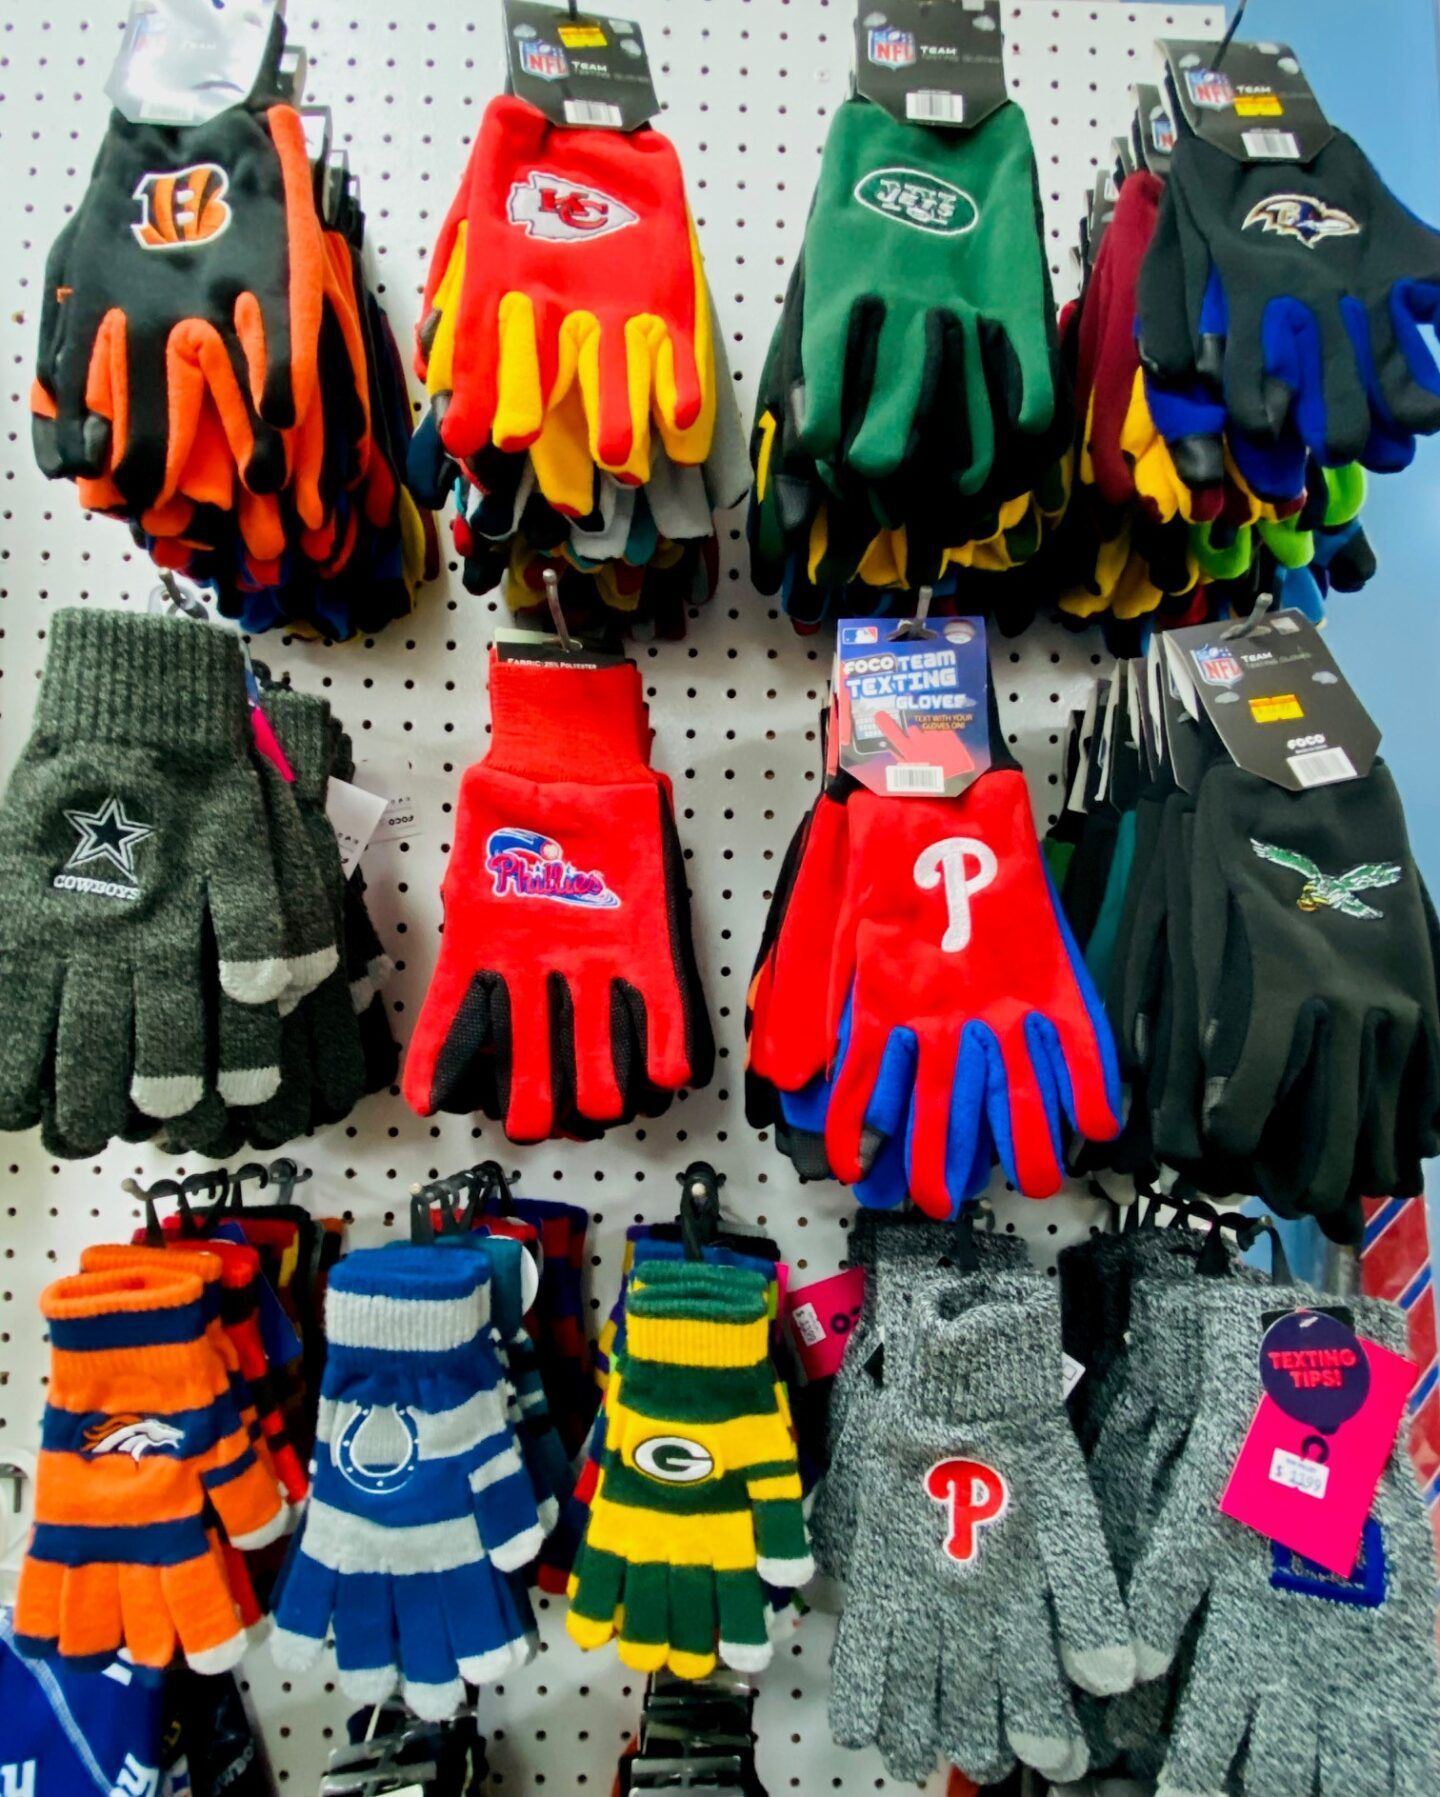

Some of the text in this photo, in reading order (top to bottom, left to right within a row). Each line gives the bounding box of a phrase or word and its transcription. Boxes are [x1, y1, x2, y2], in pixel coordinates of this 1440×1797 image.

[877, 43, 916, 62] NFL
[919, 46, 957, 56] TEAM
[529, 55, 568, 74] NFL
[571, 61, 608, 72] TEAM
[1195, 84, 1235, 103] NFL
[1236, 85, 1271, 94] TEAM
[539, 188, 609, 230] KC
[843, 656, 895, 675] FOCO
[1240, 652, 1273, 663] TEAM
[1203, 658, 1243, 680] NFL
[846, 668, 957, 698] TEXTING
[896, 694, 967, 710] GLOVES
[1286, 734, 1326, 749] FOCO
[486, 852, 605, 896] Phillies
[53, 873, 142, 900] COWBOYS
[913, 836, 999, 954] P
[1268, 1348, 1357, 1371] TEXTING
[1289, 1370, 1343, 1389] TIPS!
[923, 1456, 1008, 1562] P
